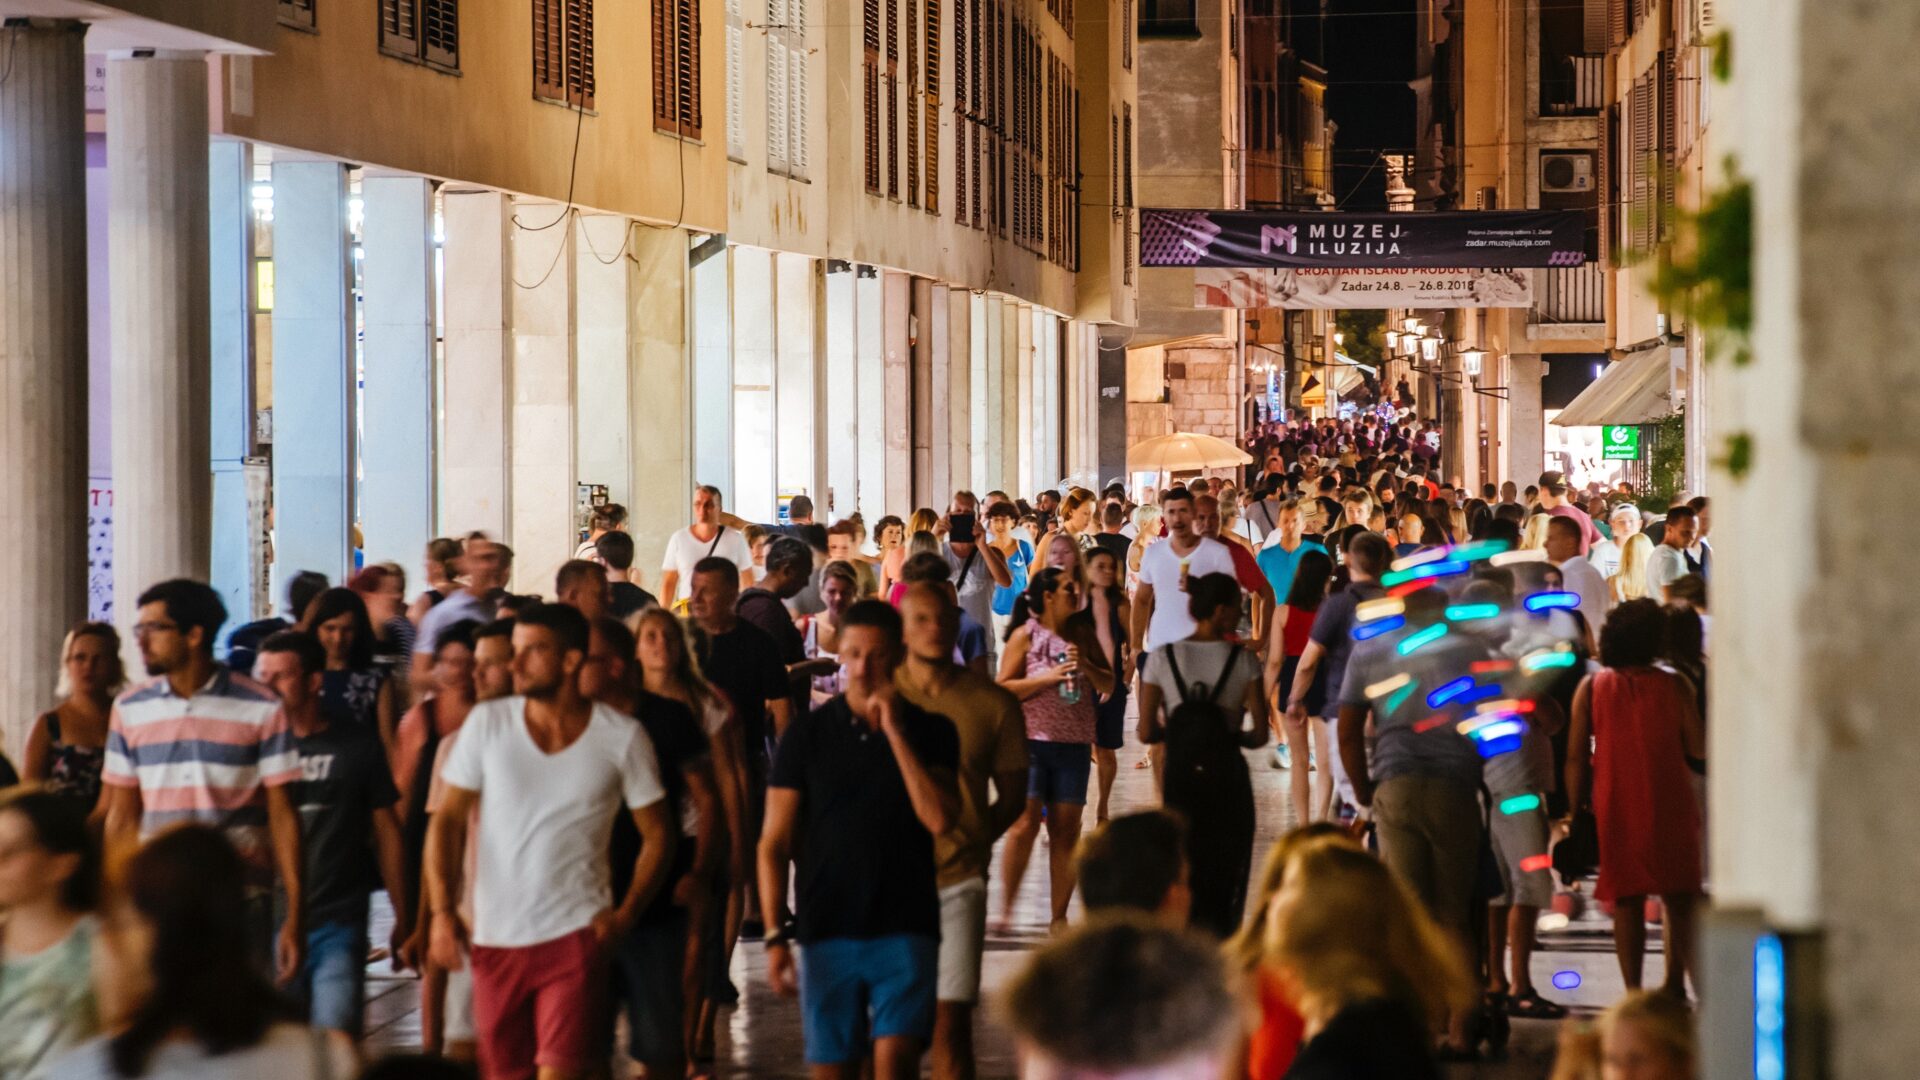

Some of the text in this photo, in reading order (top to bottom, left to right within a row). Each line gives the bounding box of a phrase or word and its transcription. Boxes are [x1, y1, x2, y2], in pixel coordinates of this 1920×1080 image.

[1309, 224, 1401, 239] MUZEJ
[1309, 242, 1401, 255] ILUZIJA
[1465, 239, 1551, 248] zadar.muzejiluzija.com
[1295, 267, 1360, 276] CROATIAN
[1363, 267, 1409, 275] ISLAND
[1341, 281, 1373, 291] Zadar
[1375, 281, 1404, 291] 24.8.
[1419, 280, 1474, 291] 26.8.2018
